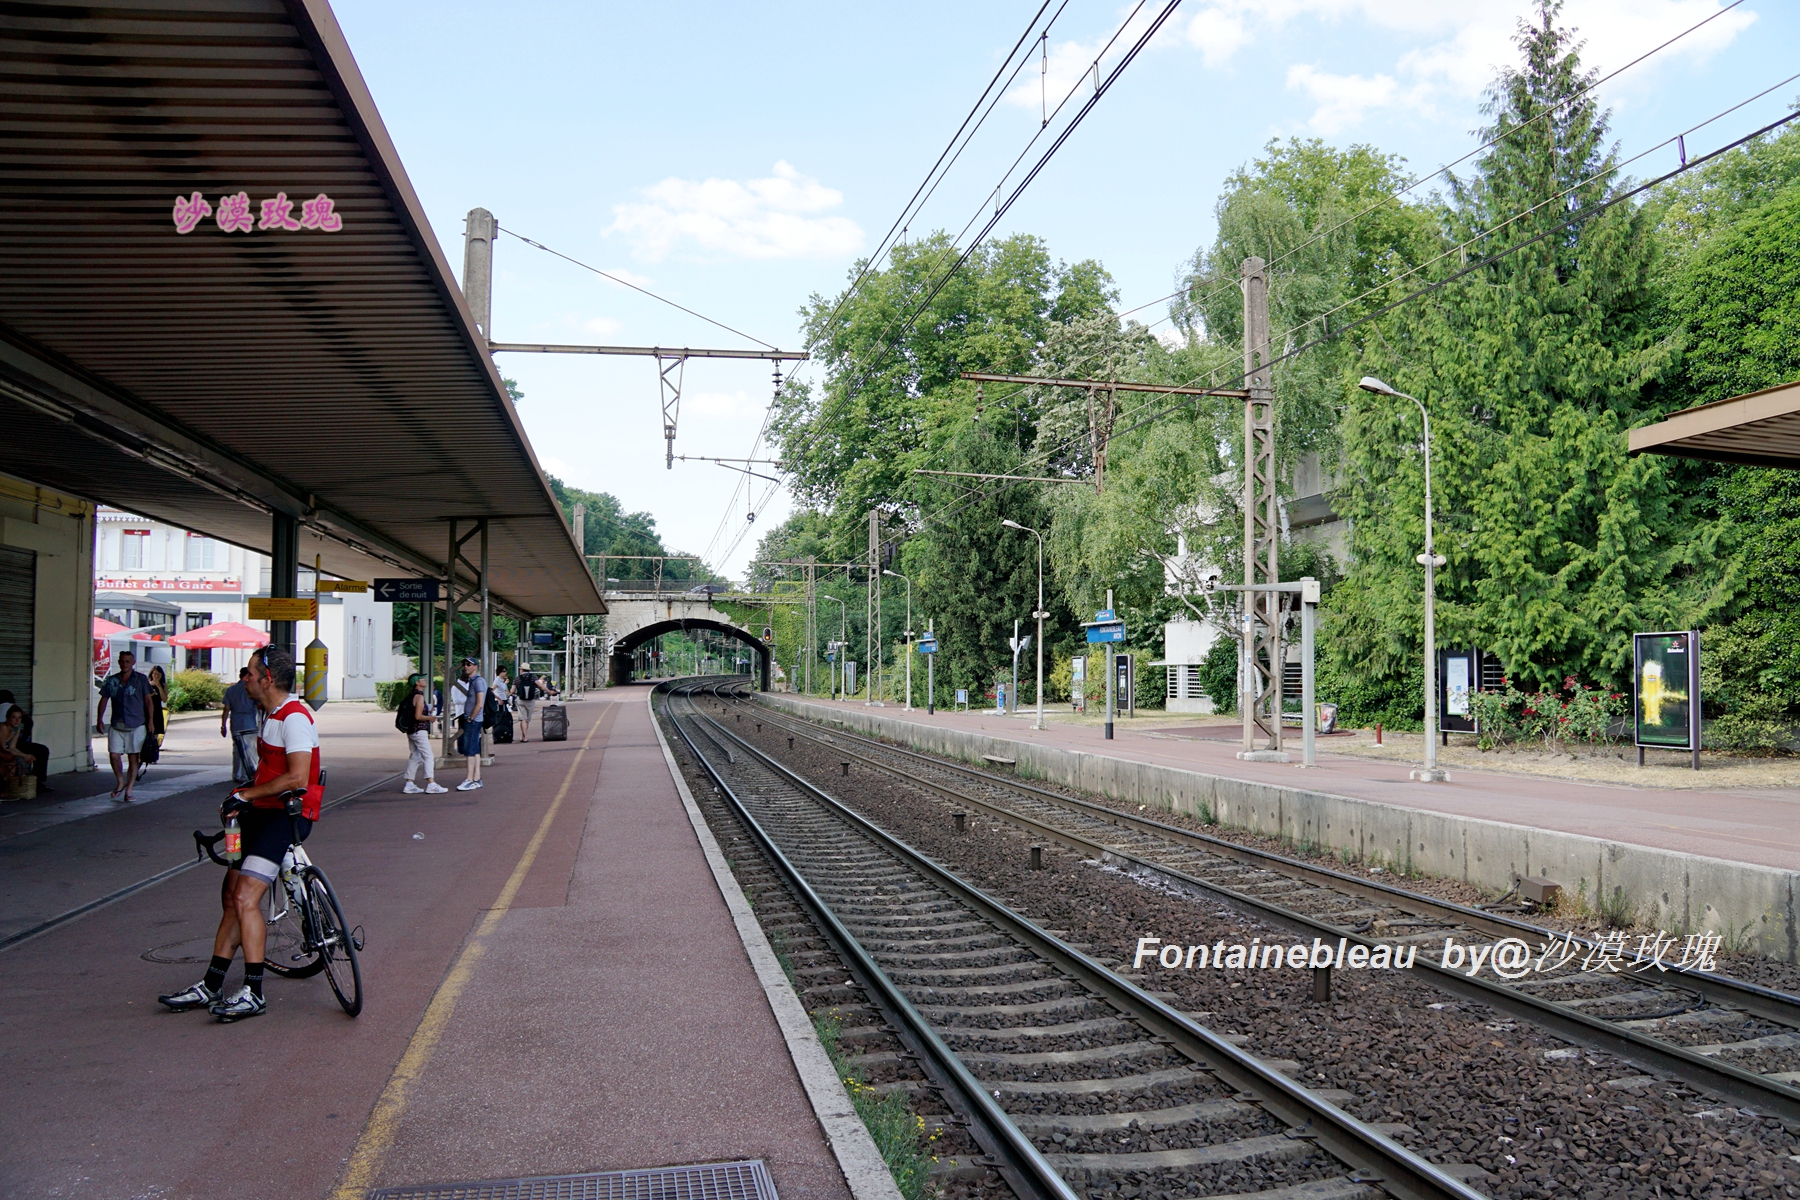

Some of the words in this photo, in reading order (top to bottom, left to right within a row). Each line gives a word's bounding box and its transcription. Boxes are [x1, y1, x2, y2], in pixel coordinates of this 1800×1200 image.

[97, 579, 138, 589] Buffet
[142, 580, 159, 589] de
[163, 580, 175, 589] la
[179, 581, 214, 590] Gare
[334, 583, 366, 592] Alarme
[399, 582, 423, 590] Sortie
